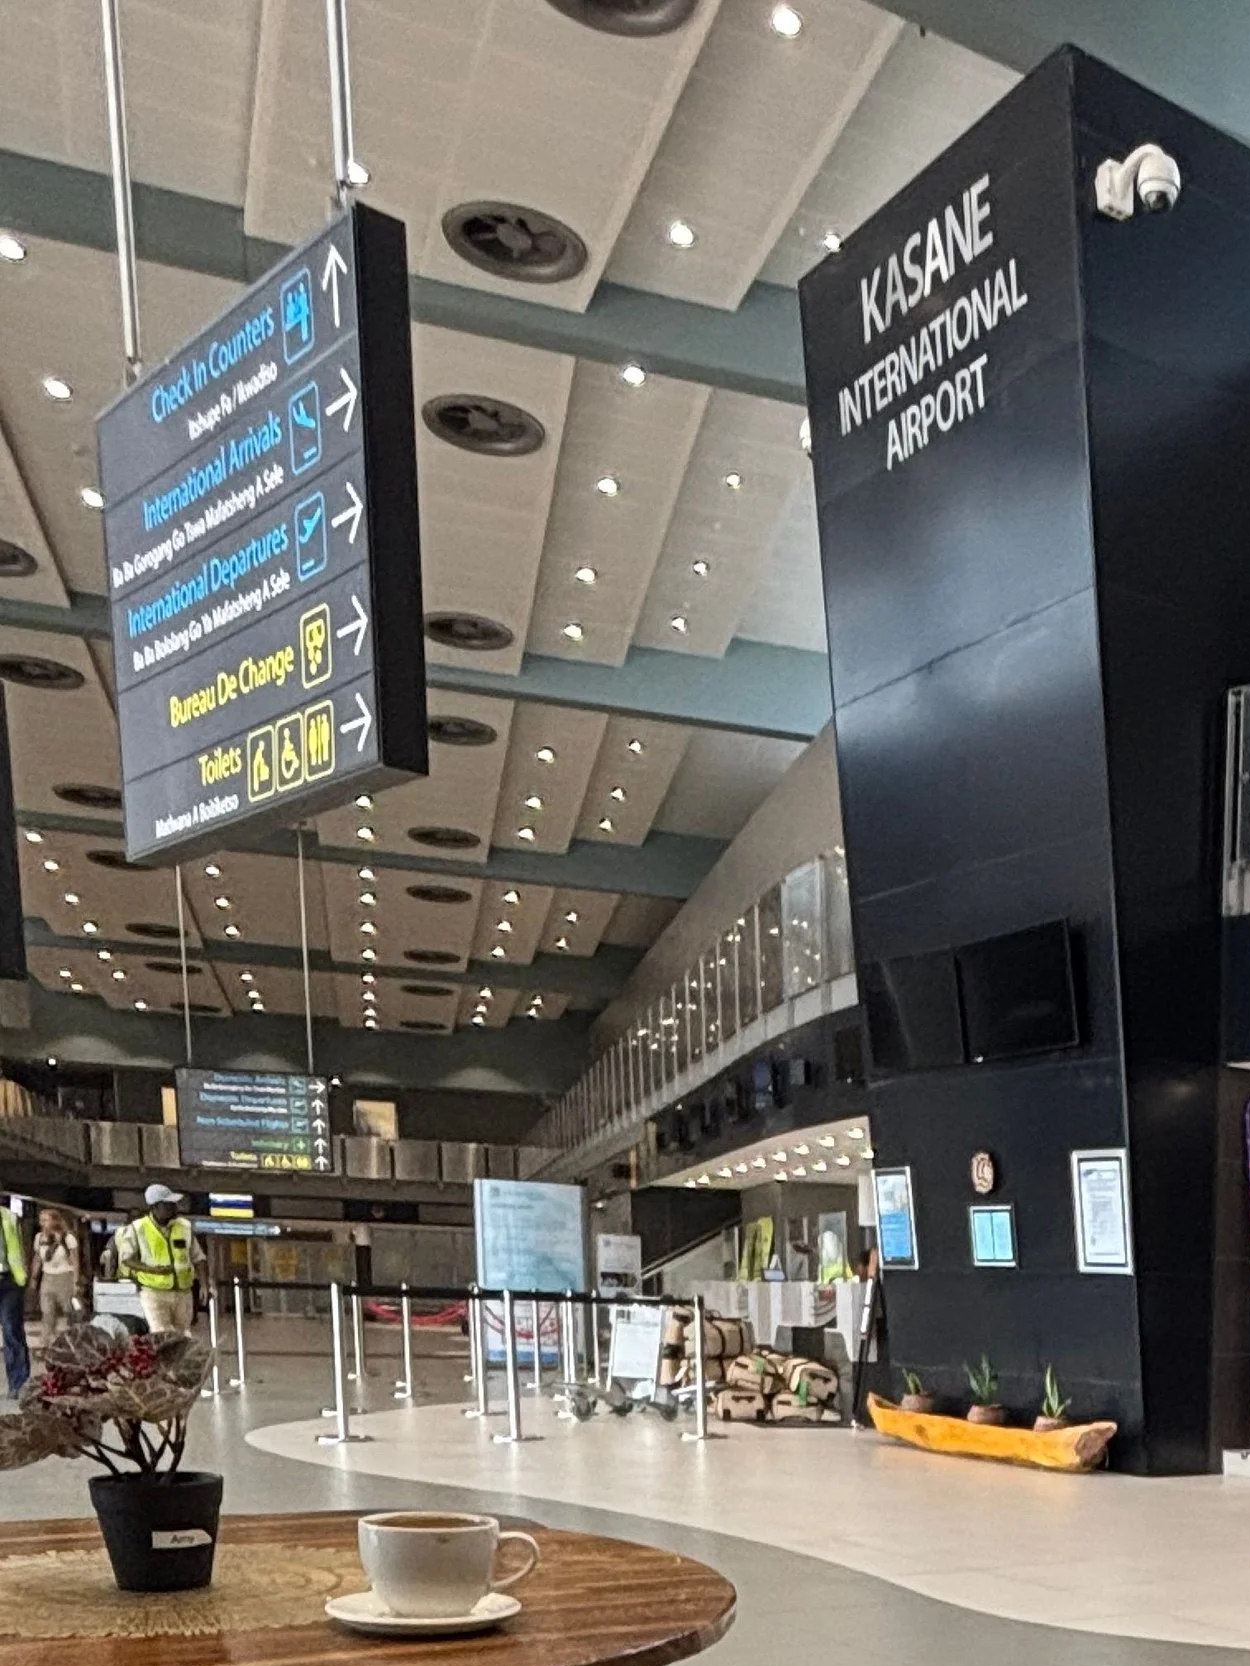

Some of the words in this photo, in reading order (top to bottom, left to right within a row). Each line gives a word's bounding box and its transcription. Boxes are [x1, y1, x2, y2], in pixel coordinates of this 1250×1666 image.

[859, 172, 994, 345] KASANE
[152, 366, 193, 423] Check
[193, 358, 208, 392] In
[208, 305, 275, 379] Counters
[837, 258, 1028, 437] INTERNATIONAL
[143, 446, 227, 531] International
[229, 410, 282, 475] Arrivals
[886, 353, 989, 471] AIRPORT
[172, 528, 186, 551] Go
[256, 475, 265, 497] A
[263, 462, 284, 493] Sele
[127, 564, 209, 640] International
[210, 523, 289, 592] Departures
[188, 620, 202, 642] Go
[262, 580, 271, 602] A
[270, 567, 291, 598] Sele
[169, 685, 216, 728] Bureau
[216, 672, 238, 706] De
[238, 645, 295, 694] Change
[198, 747, 242, 787] Toilets
